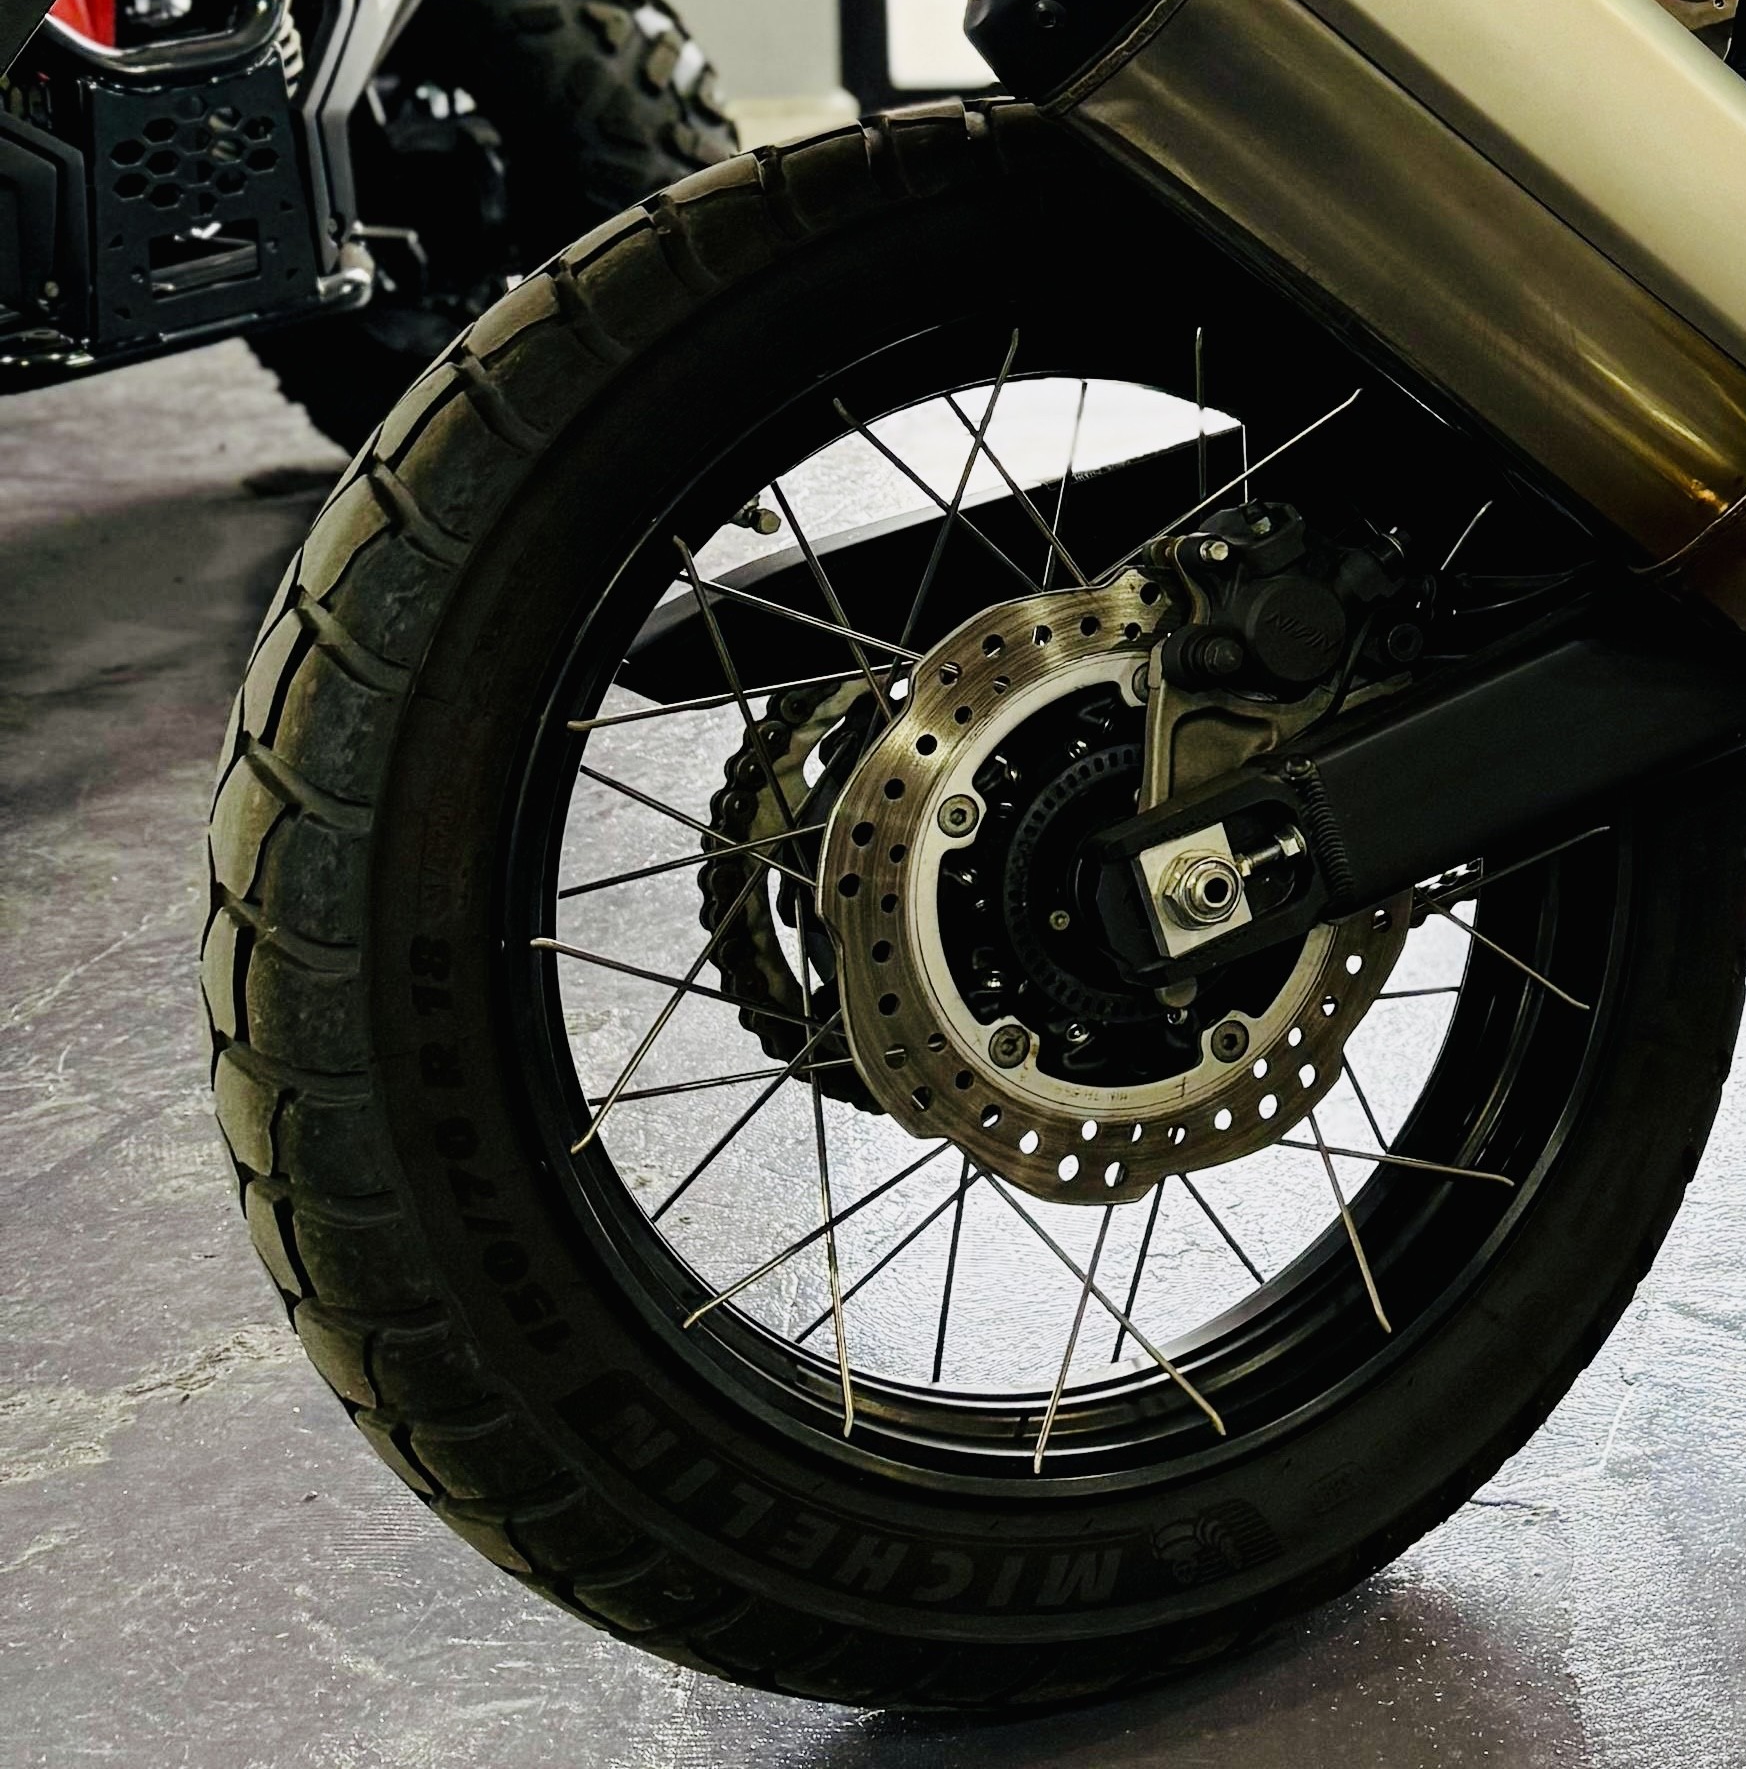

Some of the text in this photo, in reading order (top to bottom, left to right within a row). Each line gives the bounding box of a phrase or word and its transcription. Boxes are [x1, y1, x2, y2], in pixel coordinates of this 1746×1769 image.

[409, 934, 572, 1354] 150/70 R 18
[589, 1397, 1125, 1608] MICHELIN
